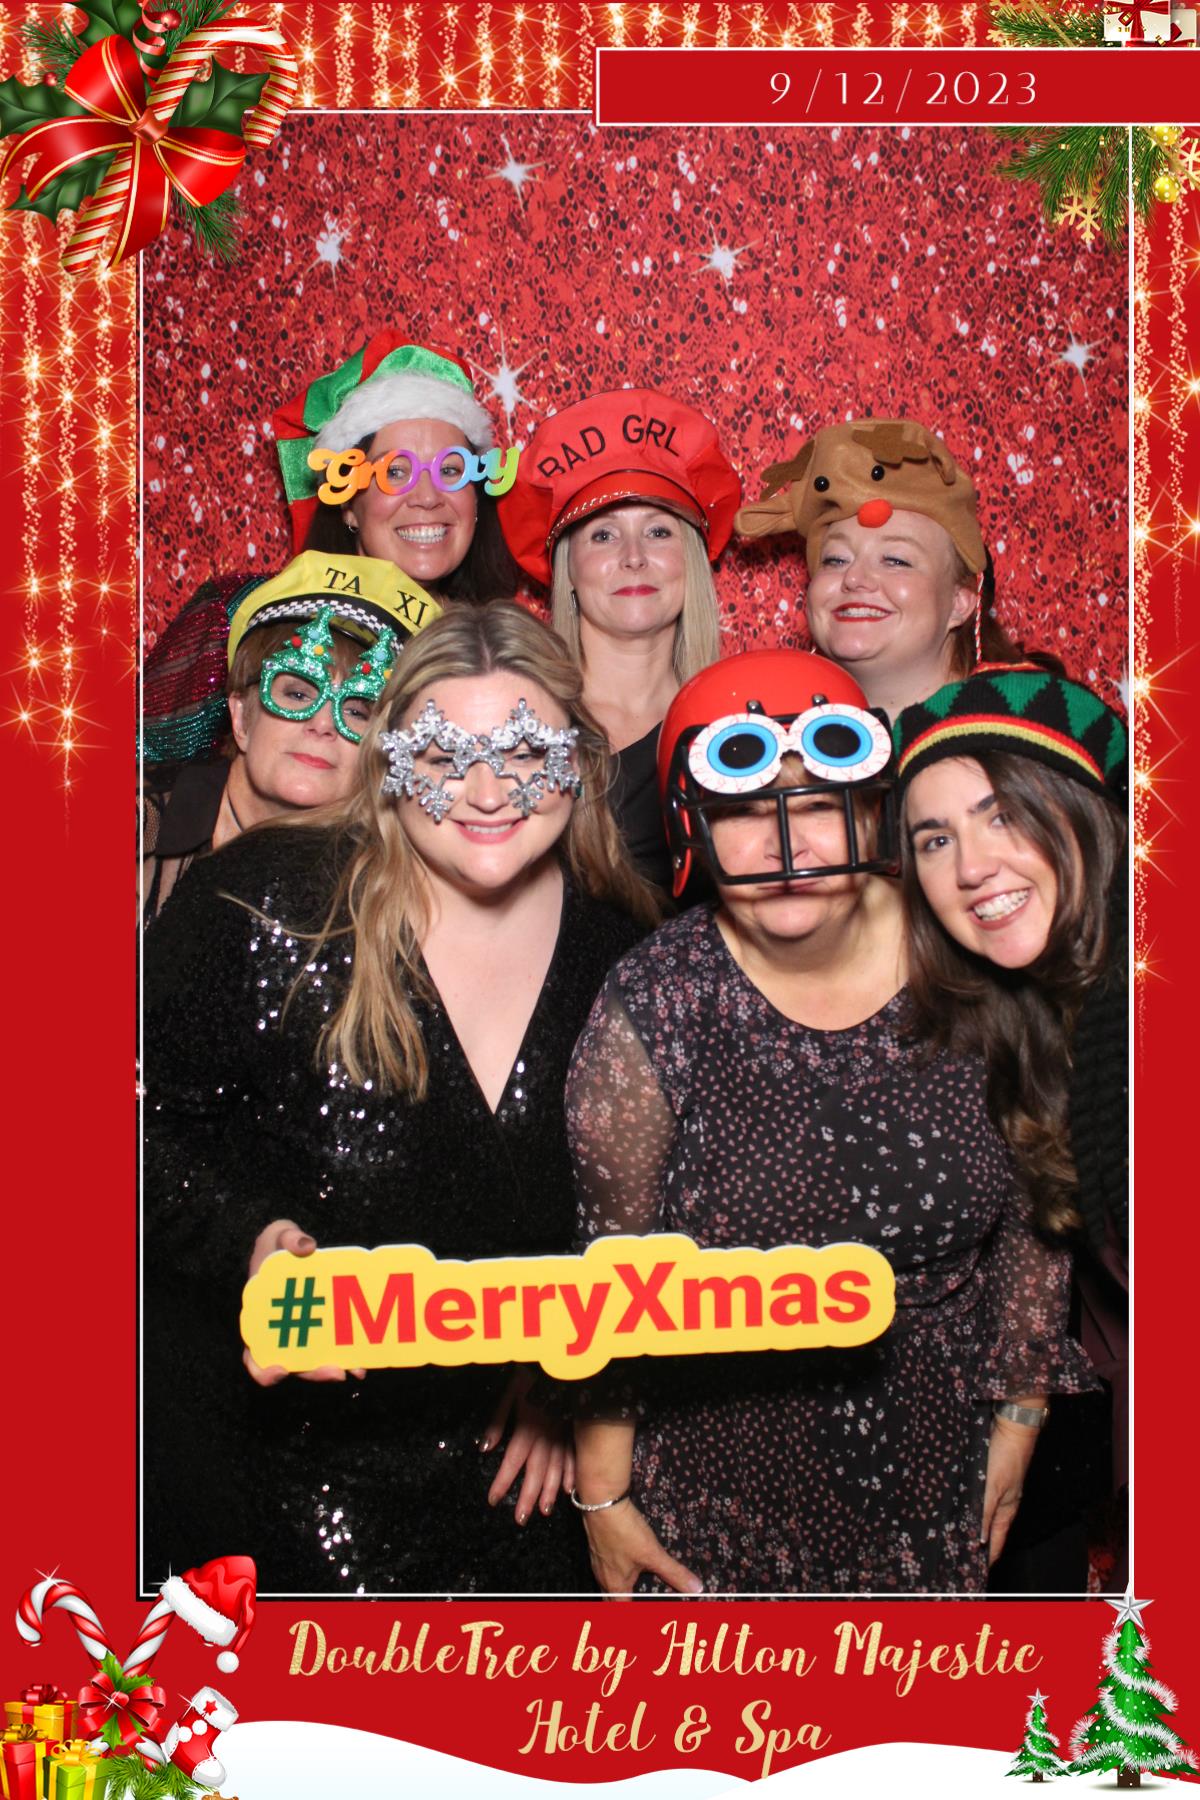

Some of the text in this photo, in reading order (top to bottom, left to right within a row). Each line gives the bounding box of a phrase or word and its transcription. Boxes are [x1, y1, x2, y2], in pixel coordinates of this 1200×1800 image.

[536, 413, 682, 479] BAD GRL
[268, 1261, 873, 1357] #MerryXmas
